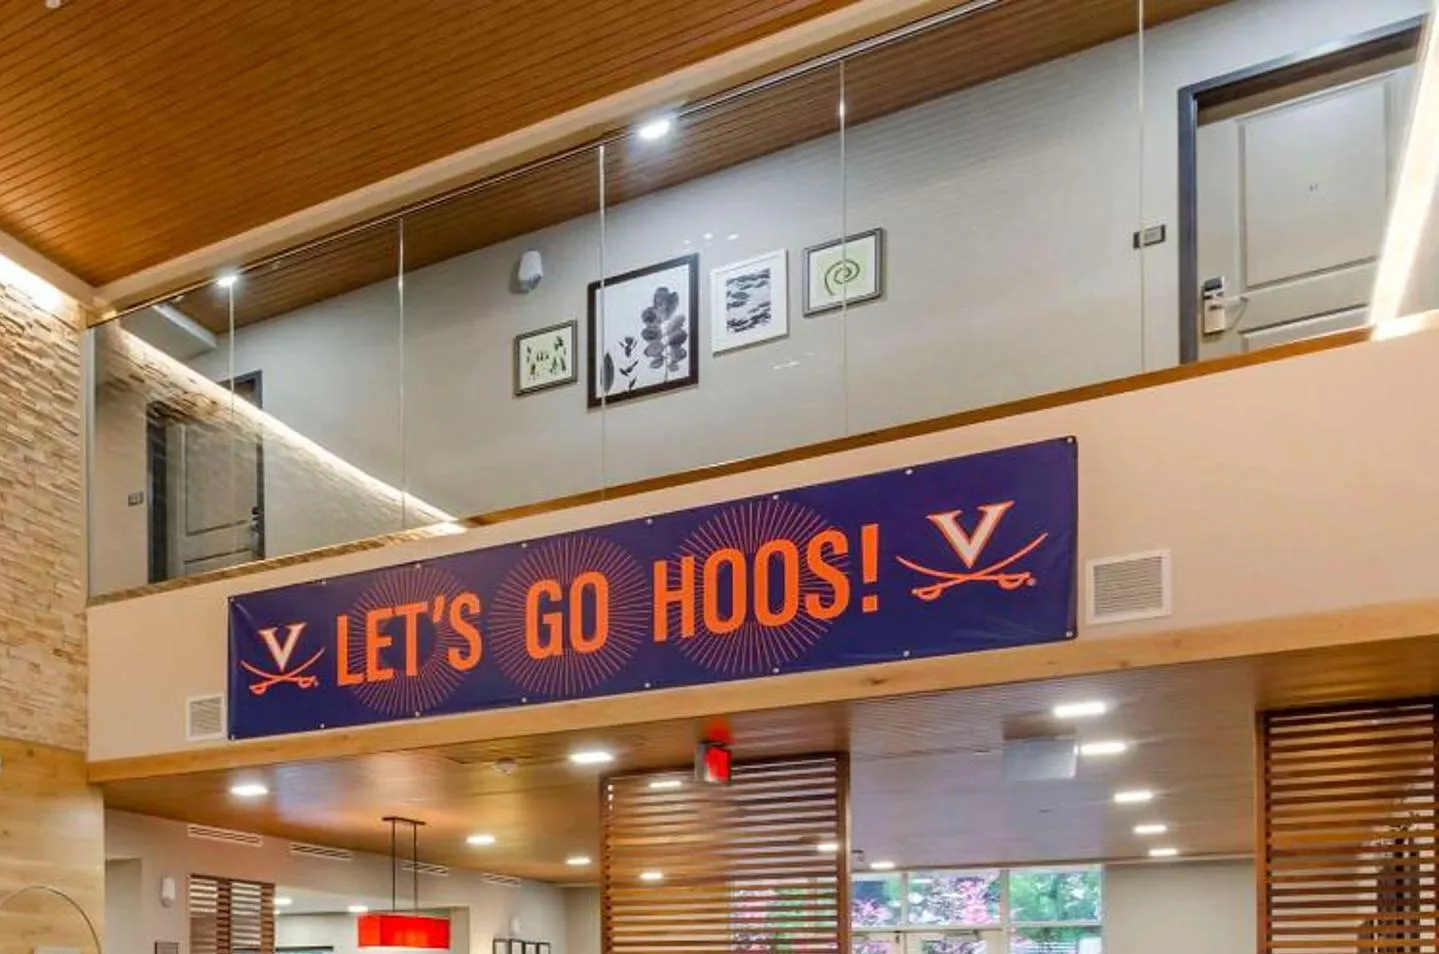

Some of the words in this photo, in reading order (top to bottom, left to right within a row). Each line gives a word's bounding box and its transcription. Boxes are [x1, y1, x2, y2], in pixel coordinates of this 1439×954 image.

[926, 500, 1015, 569] V
[337, 592, 482, 686] LET'S
[525, 571, 610, 660] GO
[653, 523, 880, 642] HOOS!
[258, 622, 308, 672] V
